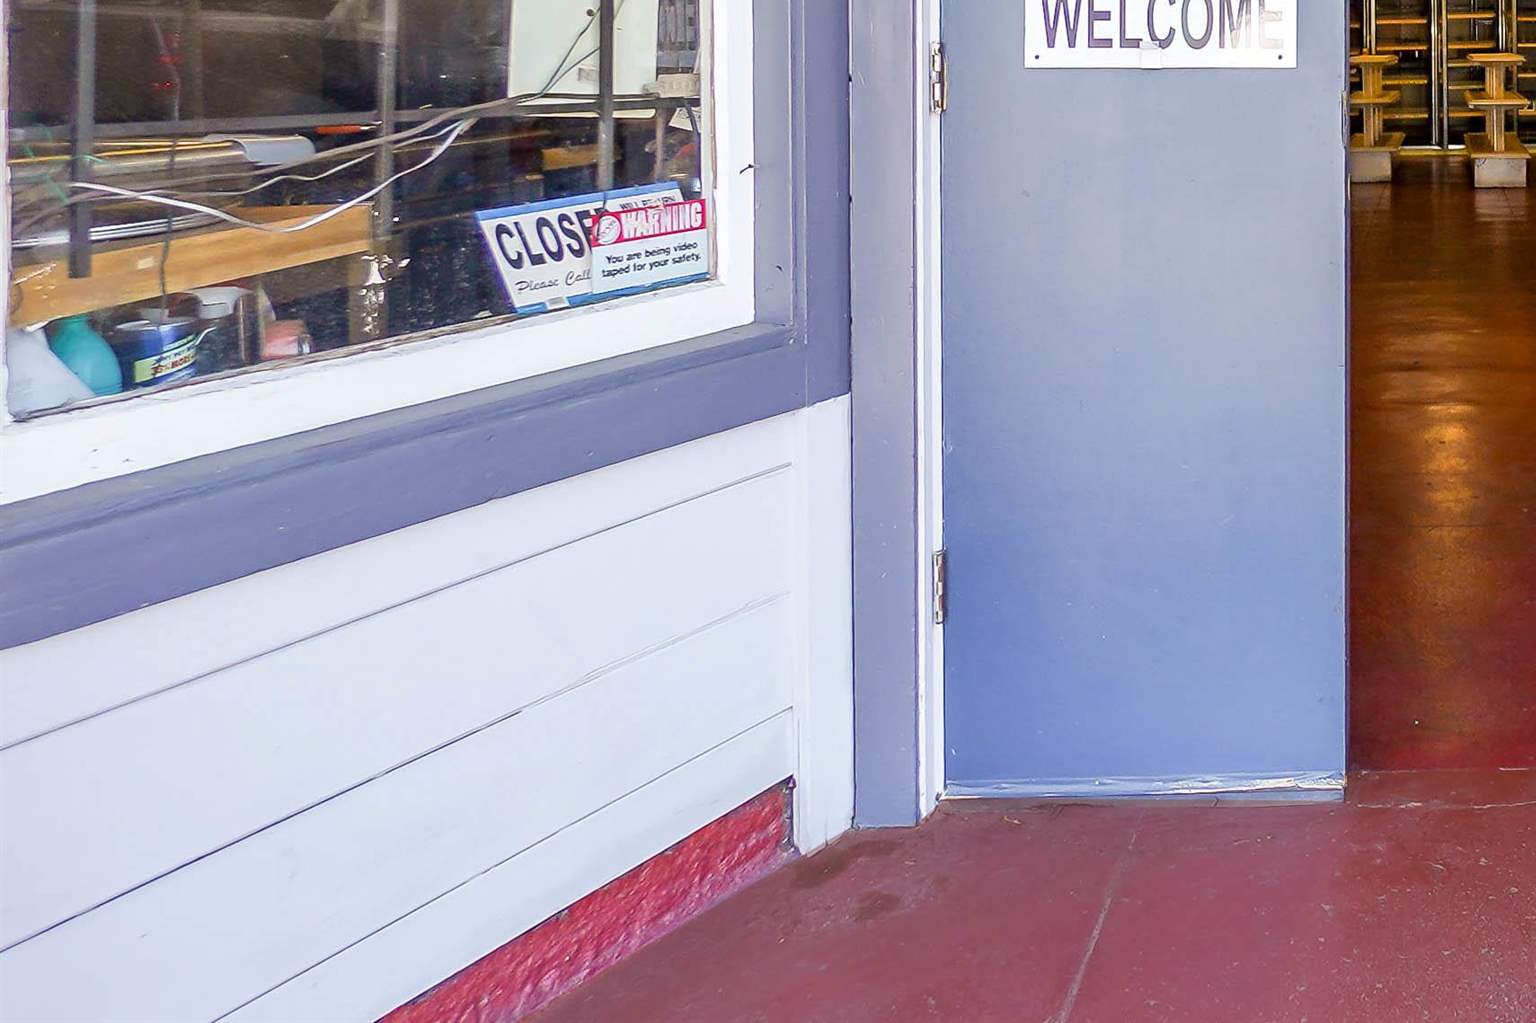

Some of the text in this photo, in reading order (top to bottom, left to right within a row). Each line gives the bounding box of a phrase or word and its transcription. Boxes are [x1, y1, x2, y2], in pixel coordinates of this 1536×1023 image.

[621, 202, 703, 239] WARNING
[605, 241, 698, 265] You are being video
[601, 264, 631, 278] taped
[632, 262, 647, 272] for
[648, 259, 670, 271] your
[514, 279, 560, 293] Please
